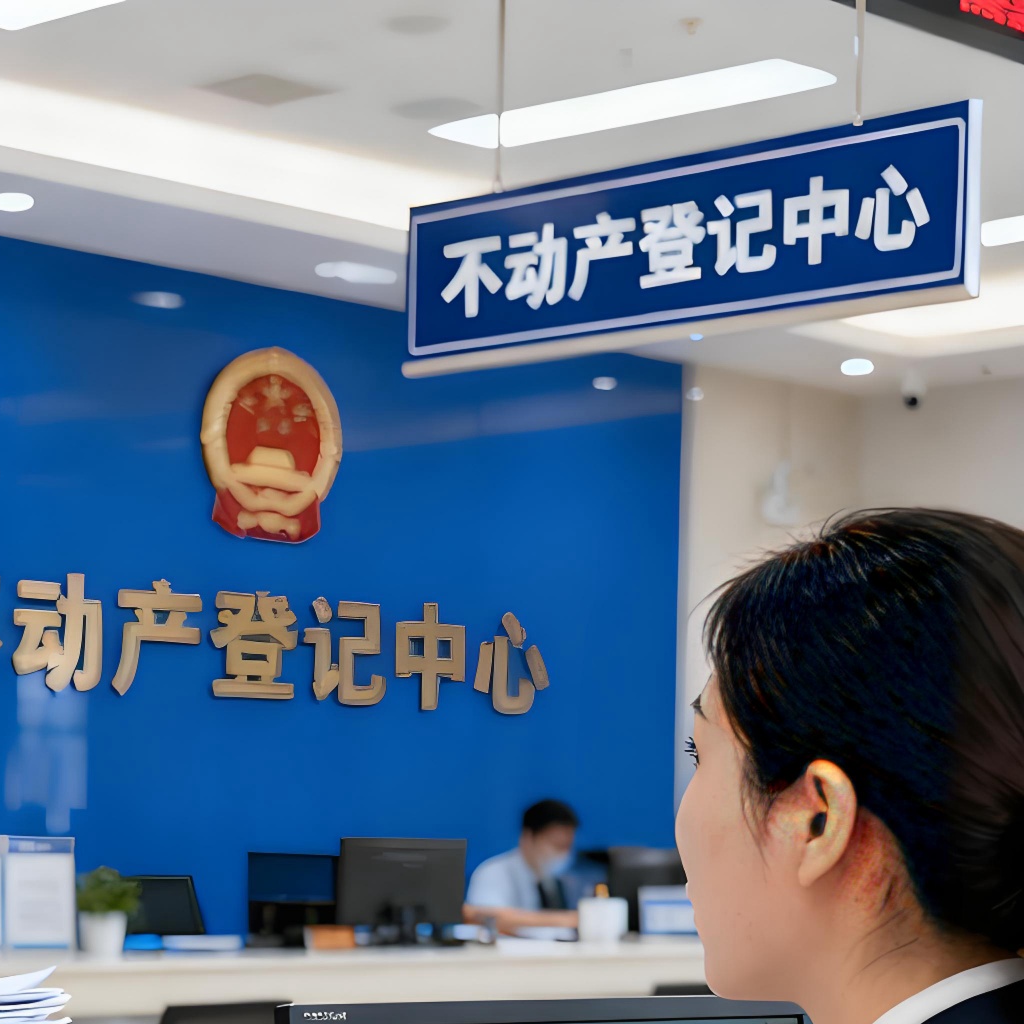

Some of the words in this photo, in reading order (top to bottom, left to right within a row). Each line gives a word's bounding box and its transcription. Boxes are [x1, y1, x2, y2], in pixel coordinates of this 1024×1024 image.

[441, 165, 931, 318] 不动产登记中心
